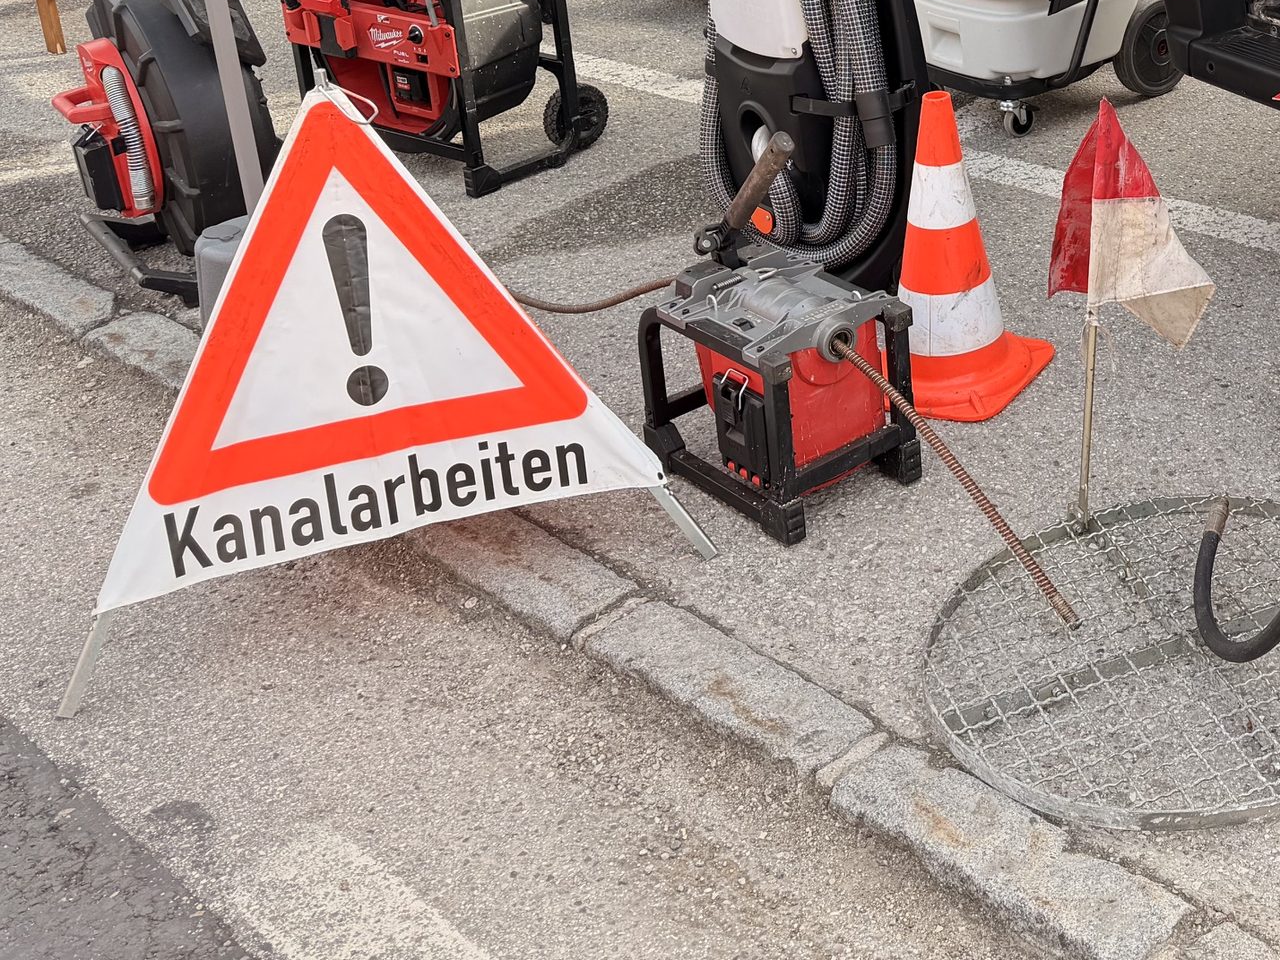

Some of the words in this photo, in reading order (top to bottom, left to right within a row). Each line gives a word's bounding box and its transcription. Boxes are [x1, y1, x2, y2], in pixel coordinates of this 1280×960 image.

[369, 27, 403, 44] Milwaukee
[393, 49, 410, 58] FUEL
[162, 440, 588, 579] Kanalarbeiten
